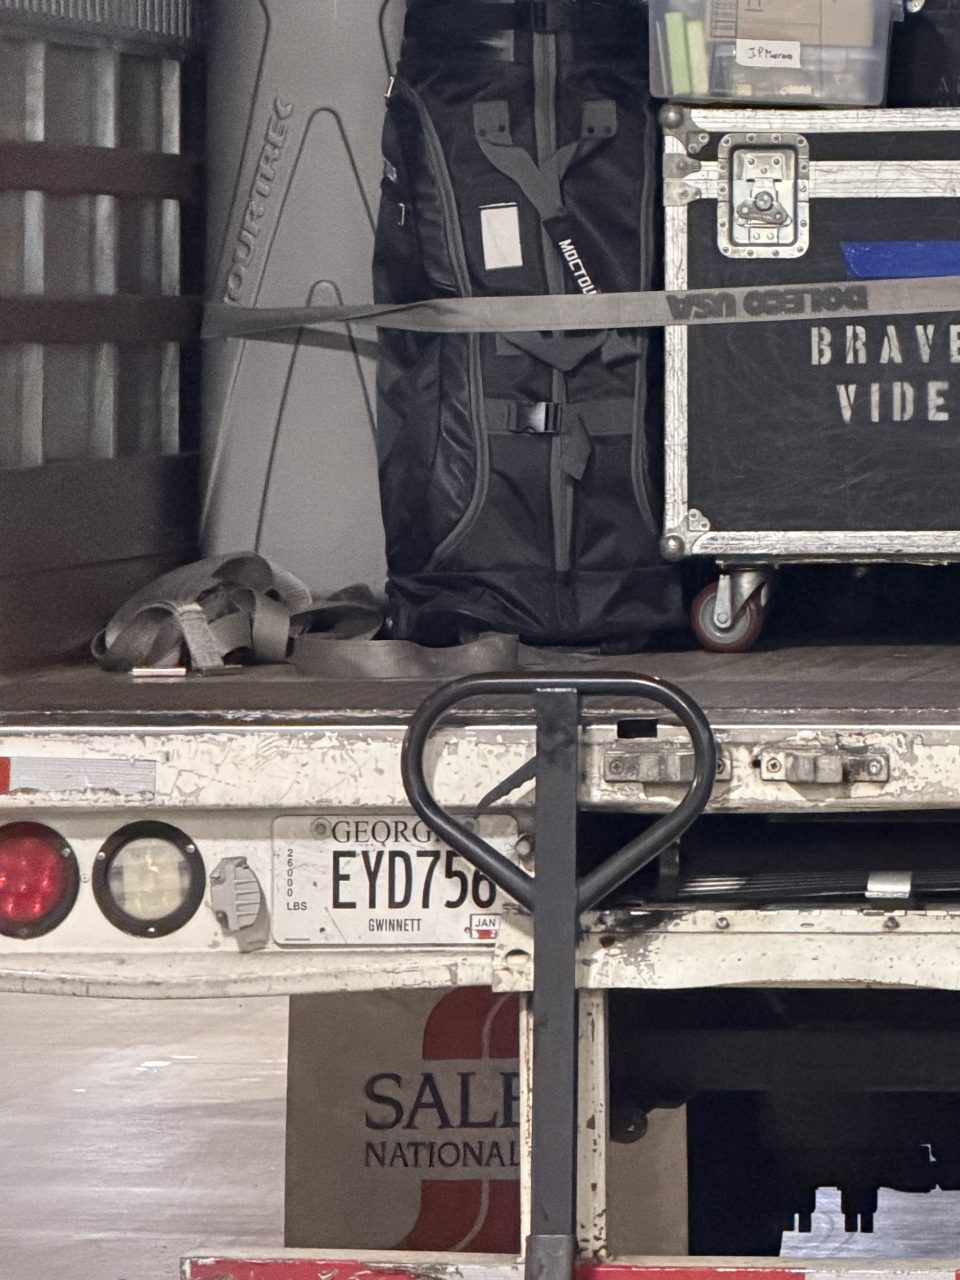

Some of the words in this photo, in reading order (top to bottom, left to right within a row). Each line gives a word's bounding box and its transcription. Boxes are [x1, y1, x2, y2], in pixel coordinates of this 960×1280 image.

[558, 238, 598, 295] MOCTOU
[666, 292, 737, 320] USA
[332, 820, 438, 845] GEORG
[332, 850, 497, 909] EYD756
[286, 901, 308, 911] LBS
[368, 918, 422, 932] GWINNETT
[474, 918, 496, 928] JAN
[365, 1072, 520, 1130] SALE
[365, 1141, 520, 1168] NATIONAL
